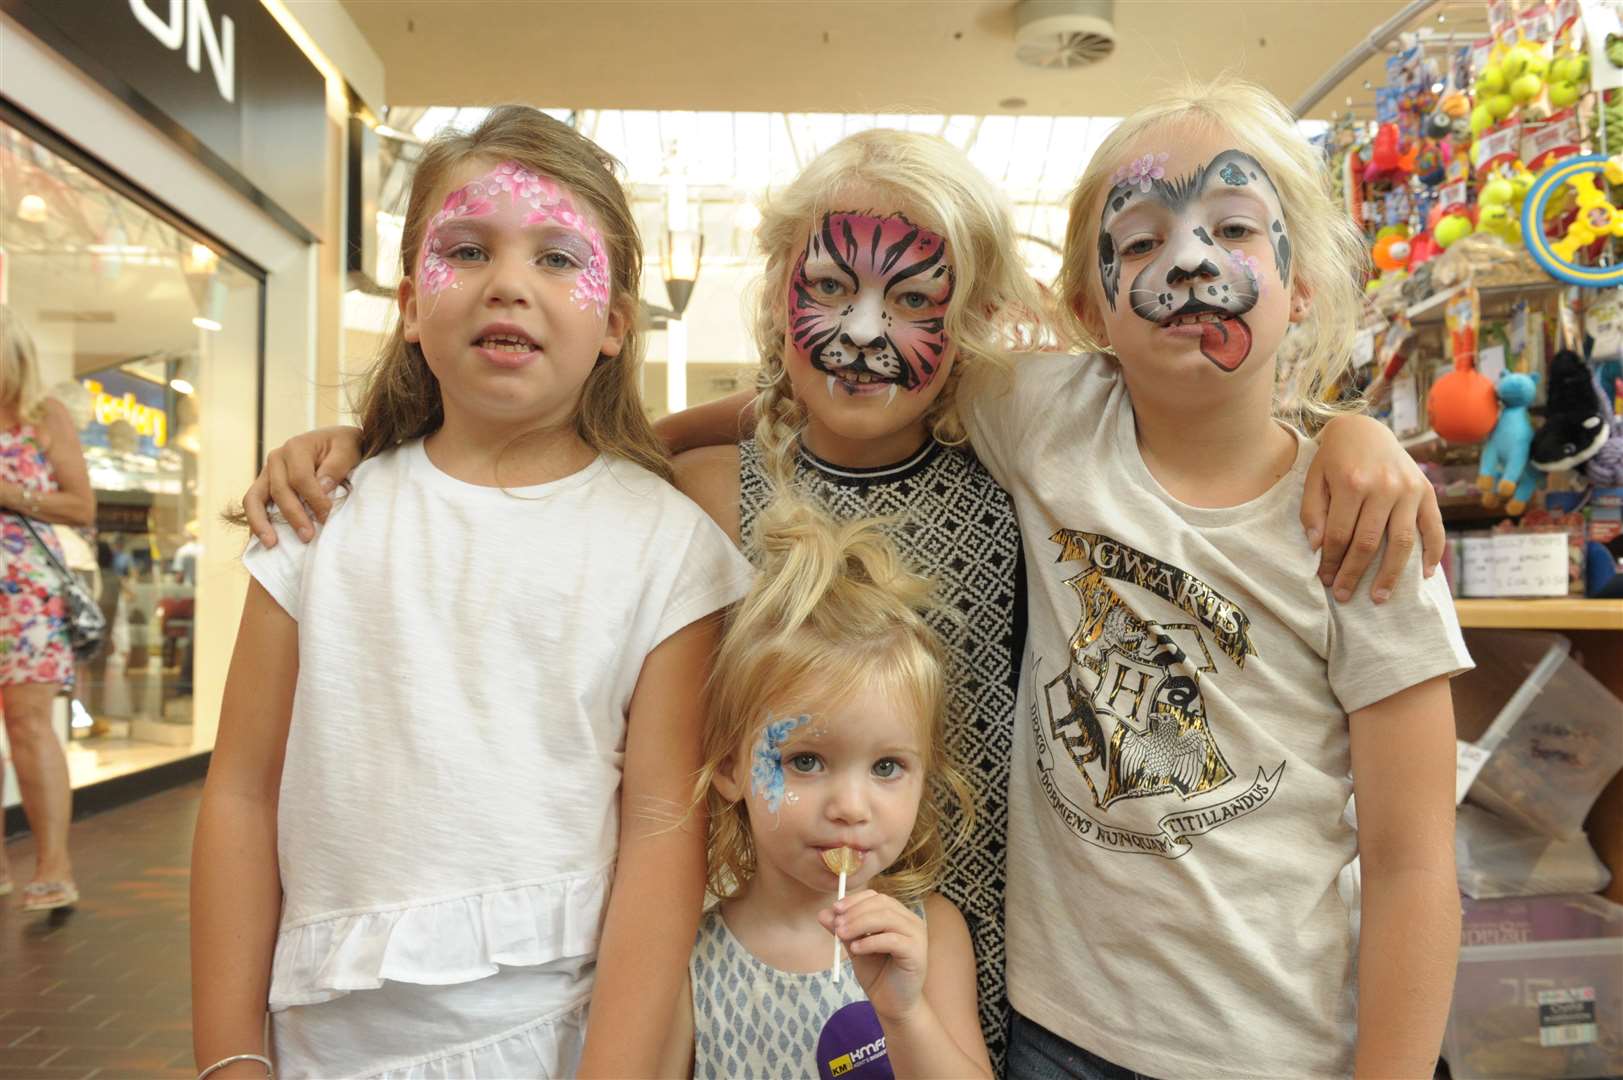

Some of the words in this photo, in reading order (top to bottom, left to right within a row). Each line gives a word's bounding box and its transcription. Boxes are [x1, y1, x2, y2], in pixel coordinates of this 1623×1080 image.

[1107, 664, 1154, 726] H
[1040, 773, 1092, 834] DORMIENS
[1163, 784, 1270, 833] TITILLANDUS
[832, 1063, 848, 1075] KM
